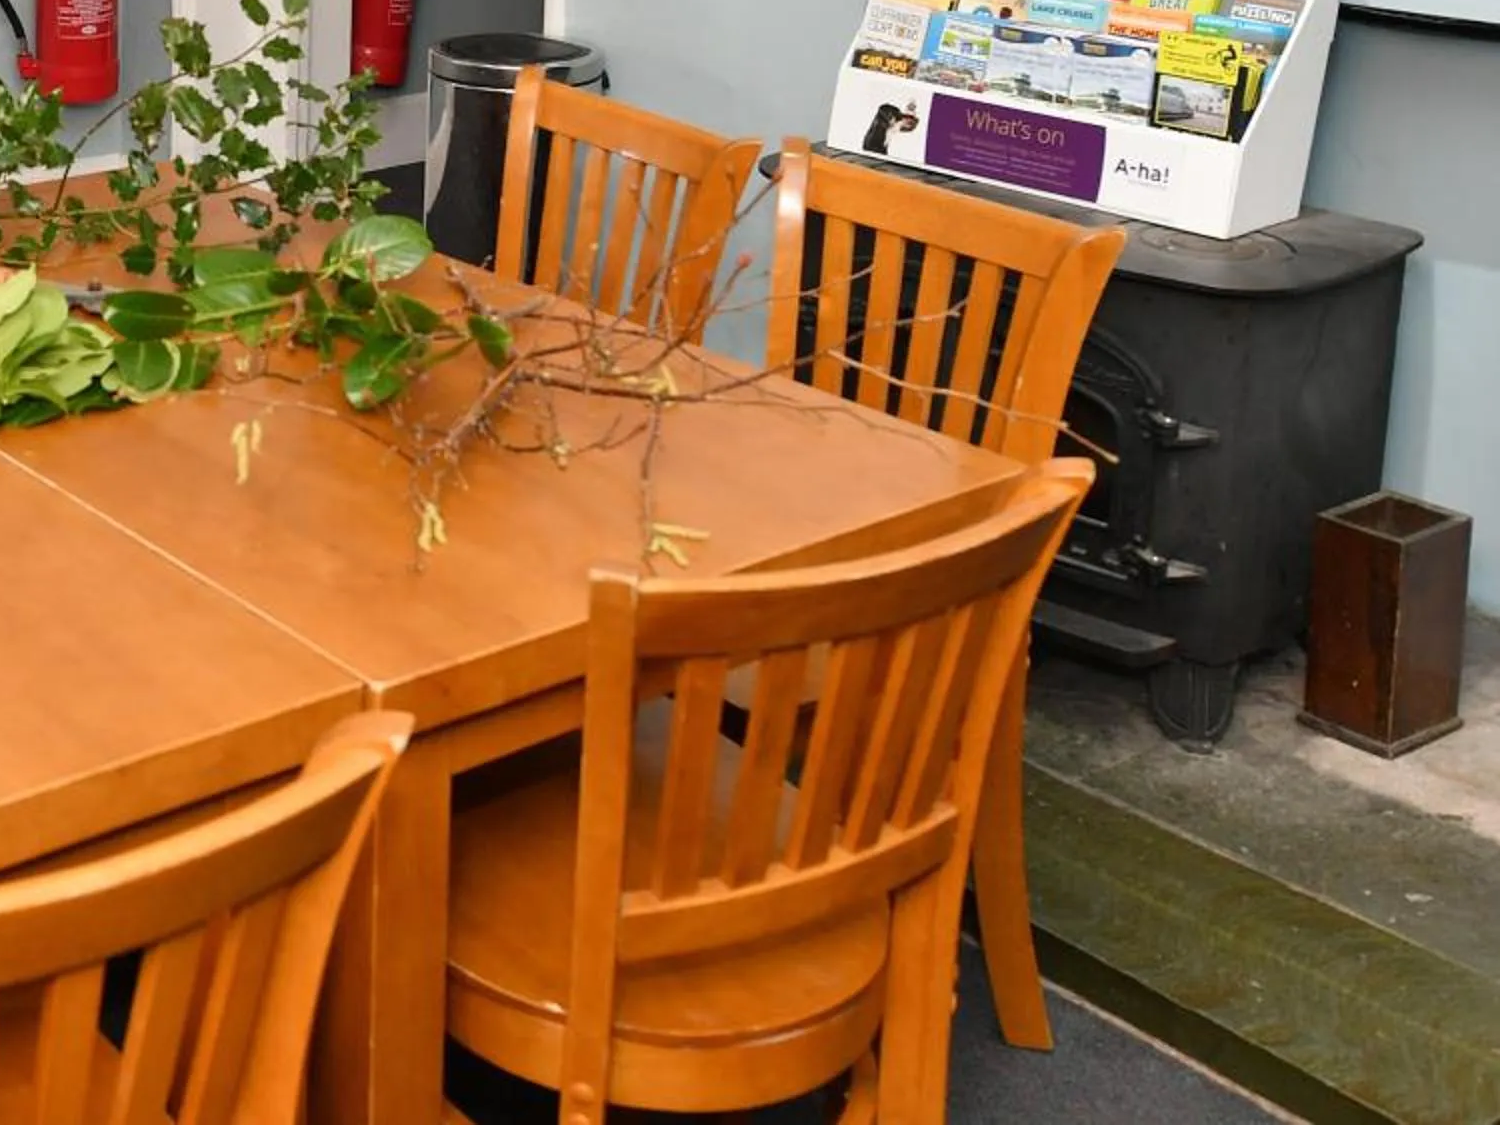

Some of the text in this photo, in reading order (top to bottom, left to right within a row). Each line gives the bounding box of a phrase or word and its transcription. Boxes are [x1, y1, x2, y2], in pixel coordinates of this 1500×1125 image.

[967, 108, 1065, 147] What's on
[1114, 158, 1170, 184] A-ha!
